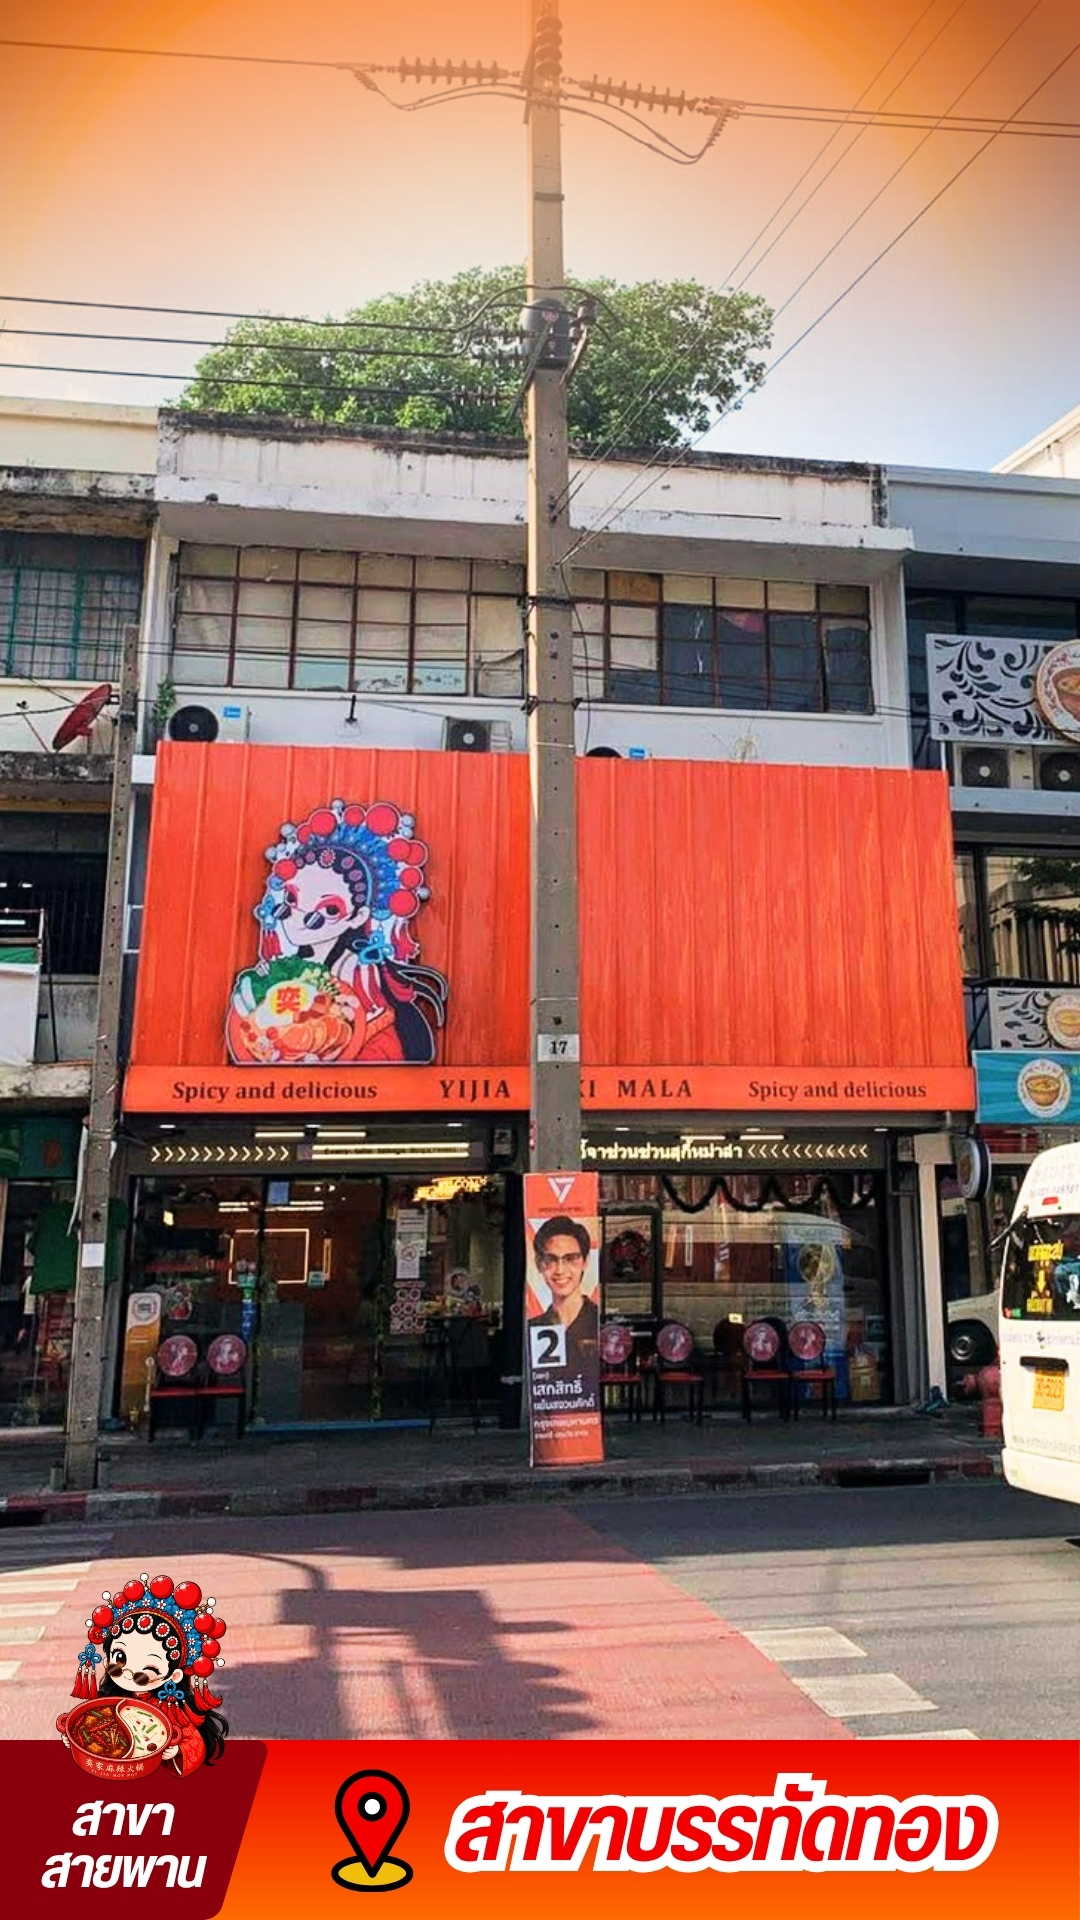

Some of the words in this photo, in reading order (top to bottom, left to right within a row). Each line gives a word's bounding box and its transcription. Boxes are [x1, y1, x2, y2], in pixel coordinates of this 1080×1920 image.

[549, 1041, 568, 1055] 17
[173, 1081, 229, 1103] Spicy
[235, 1081, 275, 1099] and
[282, 1081, 378, 1099] delicious
[439, 1079, 511, 1103] YIJIA
[617, 1079, 692, 1098] MALA
[749, 1081, 798, 1101] Spicy
[803, 1081, 838, 1098] and
[844, 1081, 927, 1098] delicious
[537, 1329, 561, 1364] 2
